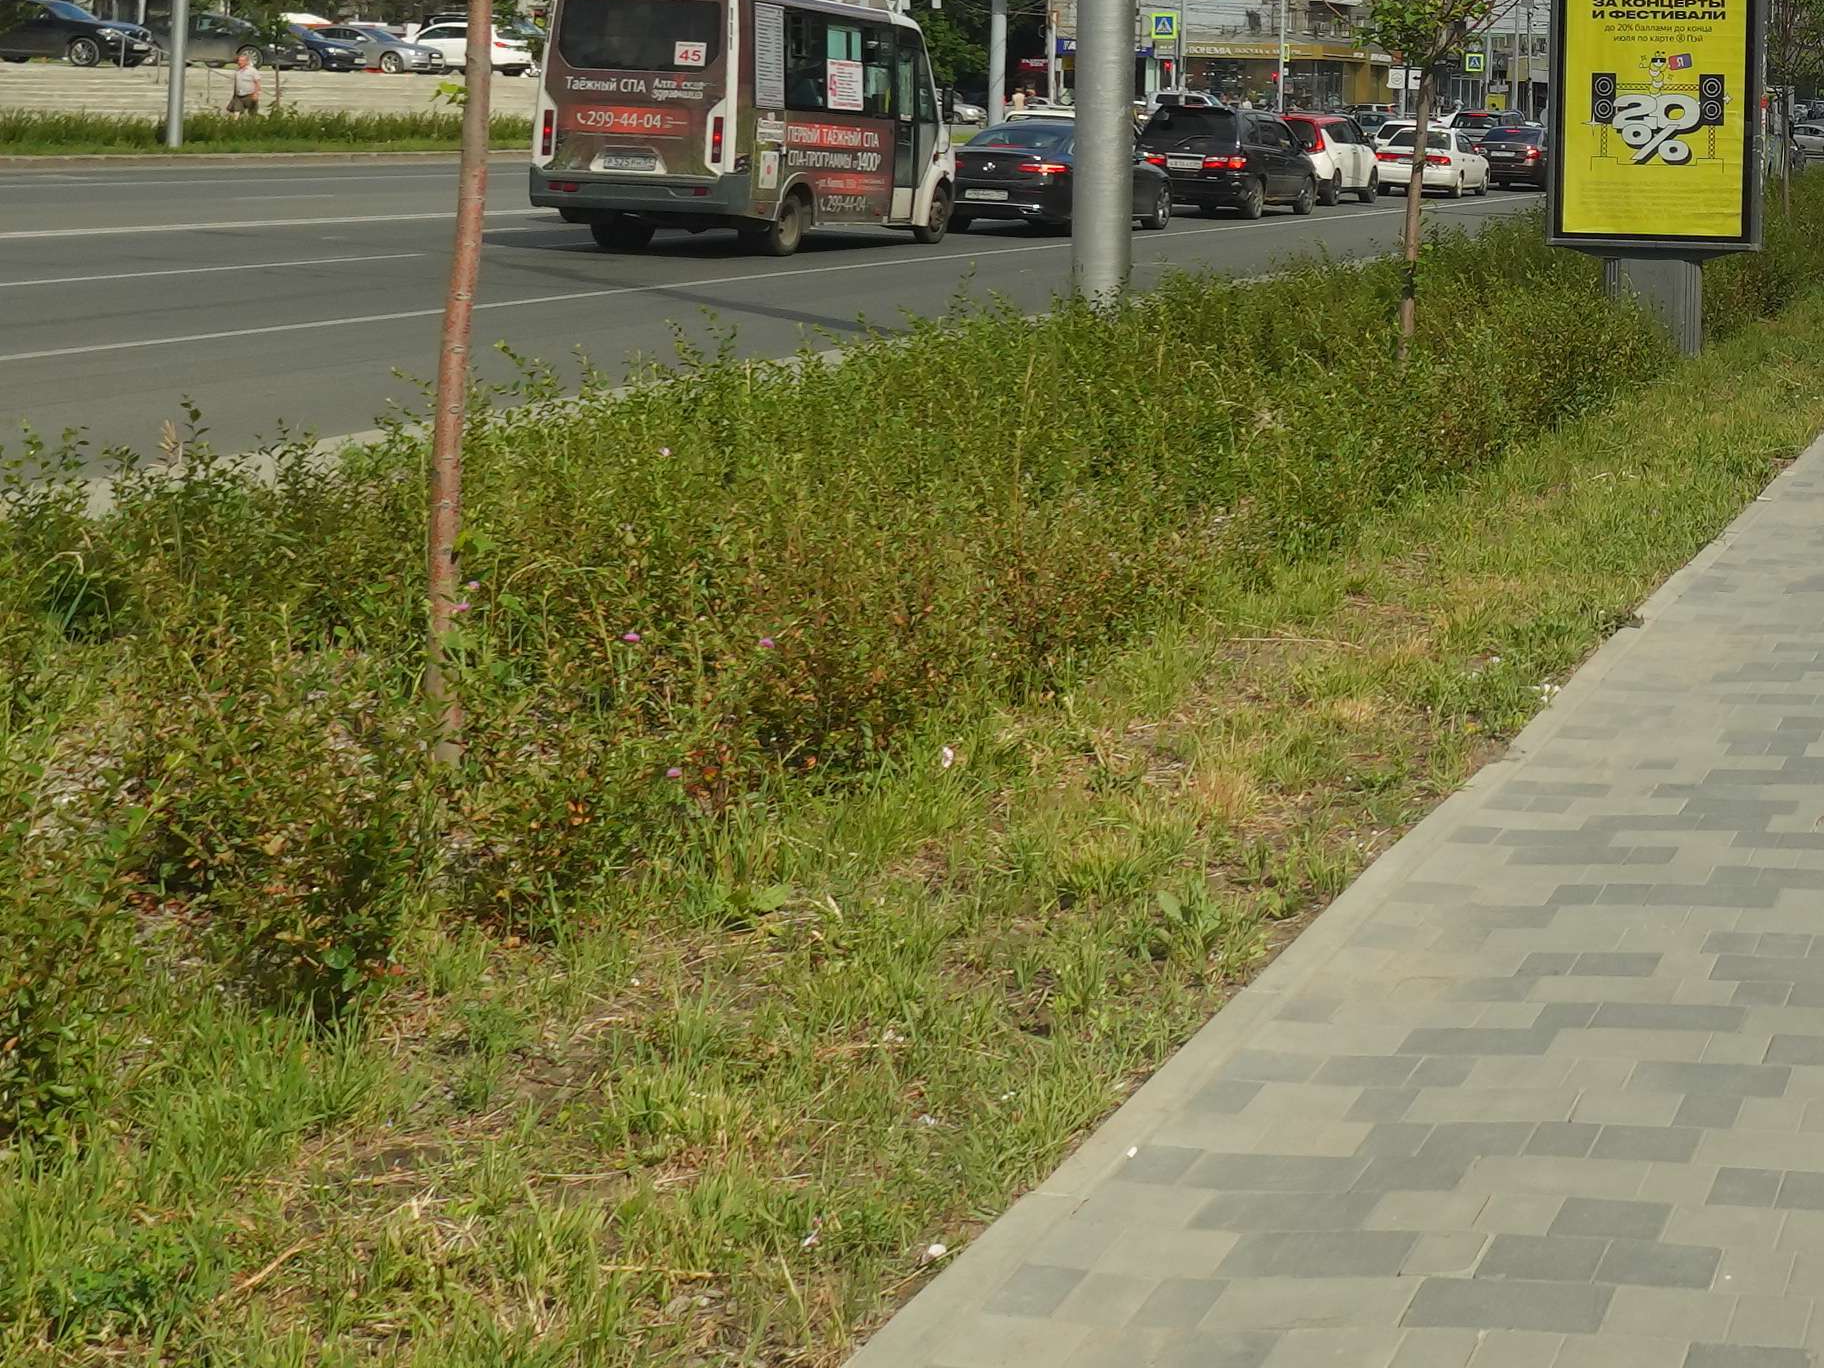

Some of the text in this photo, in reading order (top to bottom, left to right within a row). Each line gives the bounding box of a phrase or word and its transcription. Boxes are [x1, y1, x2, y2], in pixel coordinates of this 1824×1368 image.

[1592, 10, 1726, 20] И ФЕСТИВАЛИ
[1604, 24, 1615, 32] до
[1617, 23, 1633, 31] 20%
[1635, 23, 1672, 32] баллами
[1687, 25, 1712, 33] конца
[1650, 35, 1675, 43] карте
[680, 50, 701, 62] 45
[566, 76, 647, 93] Таёжный СПА
[587, 111, 662, 128] 299-44-04
[788, 125, 820, 143] ПЕРВЫЙ
[823, 126, 861, 146] ТАЁЖНЫЙ
[863, 132, 879, 148] СПА
[788, 150, 852, 169] СПА-ПРОГРАММЫ
[828, 195, 866, 213] 299-44-04
